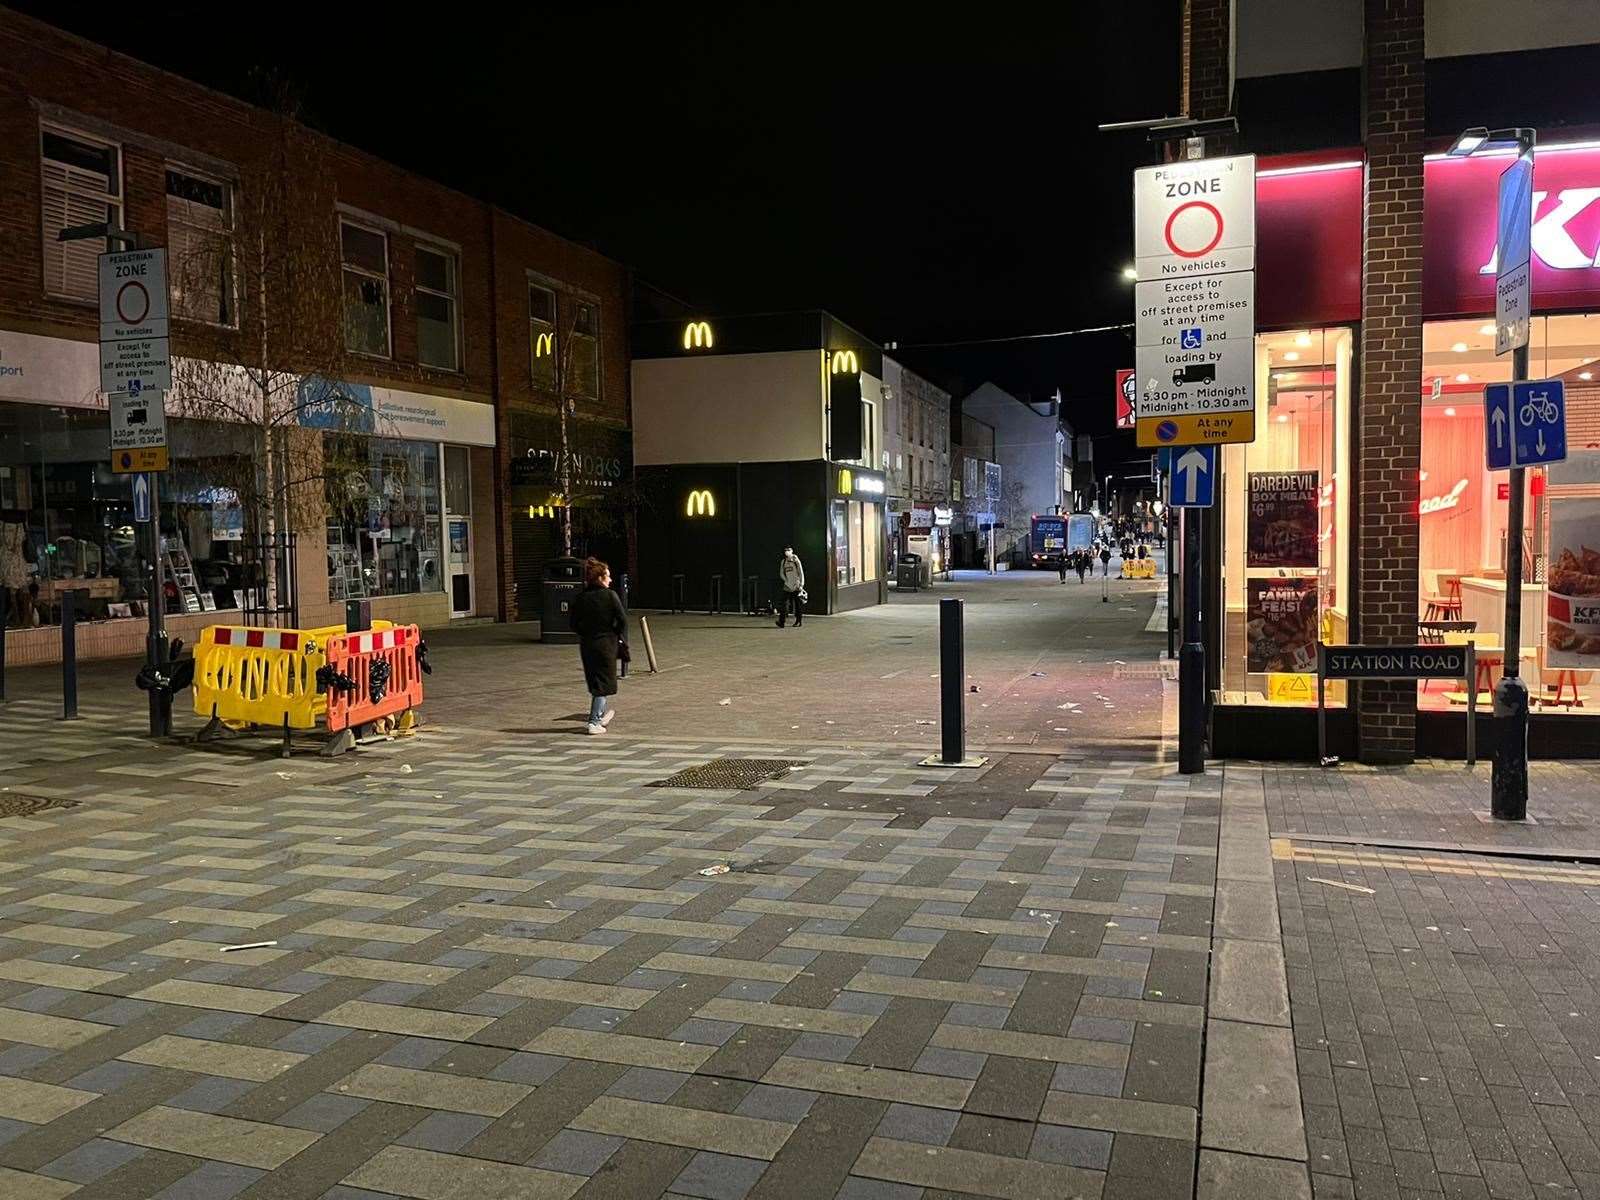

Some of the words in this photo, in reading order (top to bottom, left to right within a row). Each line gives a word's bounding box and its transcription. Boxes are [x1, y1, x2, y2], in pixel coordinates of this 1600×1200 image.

[1166, 178, 1221, 198] ZONE
[110, 252, 153, 264] PEDESTRIAN
[116, 264, 147, 278] ZONE
[1162, 264, 1177, 273] No
[1181, 260, 1226, 271] vehicles
[1165, 280, 1203, 292] Except
[1207, 279, 1222, 288] for
[1498, 274, 1527, 297] Pedestrian
[1168, 293, 1204, 303] access
[1209, 291, 1220, 299] to
[1141, 307, 1157, 317] off
[1161, 304, 1193, 315] street
[1197, 300, 1248, 313] premises
[1504, 298, 1518, 313] Zone
[1163, 317, 1173, 326] at
[1177, 316, 1197, 326] any
[1200, 313, 1225, 323] time
[1161, 336, 1177, 345] for
[1206, 331, 1227, 341] and
[1165, 352, 1205, 363] loading
[1209, 351, 1222, 361] by
[1143, 391, 1169, 401] 5.30
[1171, 392, 1188, 401] pm
[1197, 386, 1247, 398] Midnight
[1140, 401, 1189, 413] Midnight
[1198, 398, 1230, 409] 10.30
[1232, 399, 1249, 407] am
[1197, 419, 1209, 427] At
[1214, 418, 1234, 428] any
[1203, 429, 1228, 438] time
[1252, 475, 1314, 492] DAREDEVIL
[1253, 493, 1277, 502] BOX
[1281, 491, 1314, 501] MEAL
[1258, 591, 1306, 601] FAMILY
[1261, 601, 1301, 612] FEAST
[1331, 655, 1403, 670] STATION
[1410, 655, 1460, 670] ROAD
